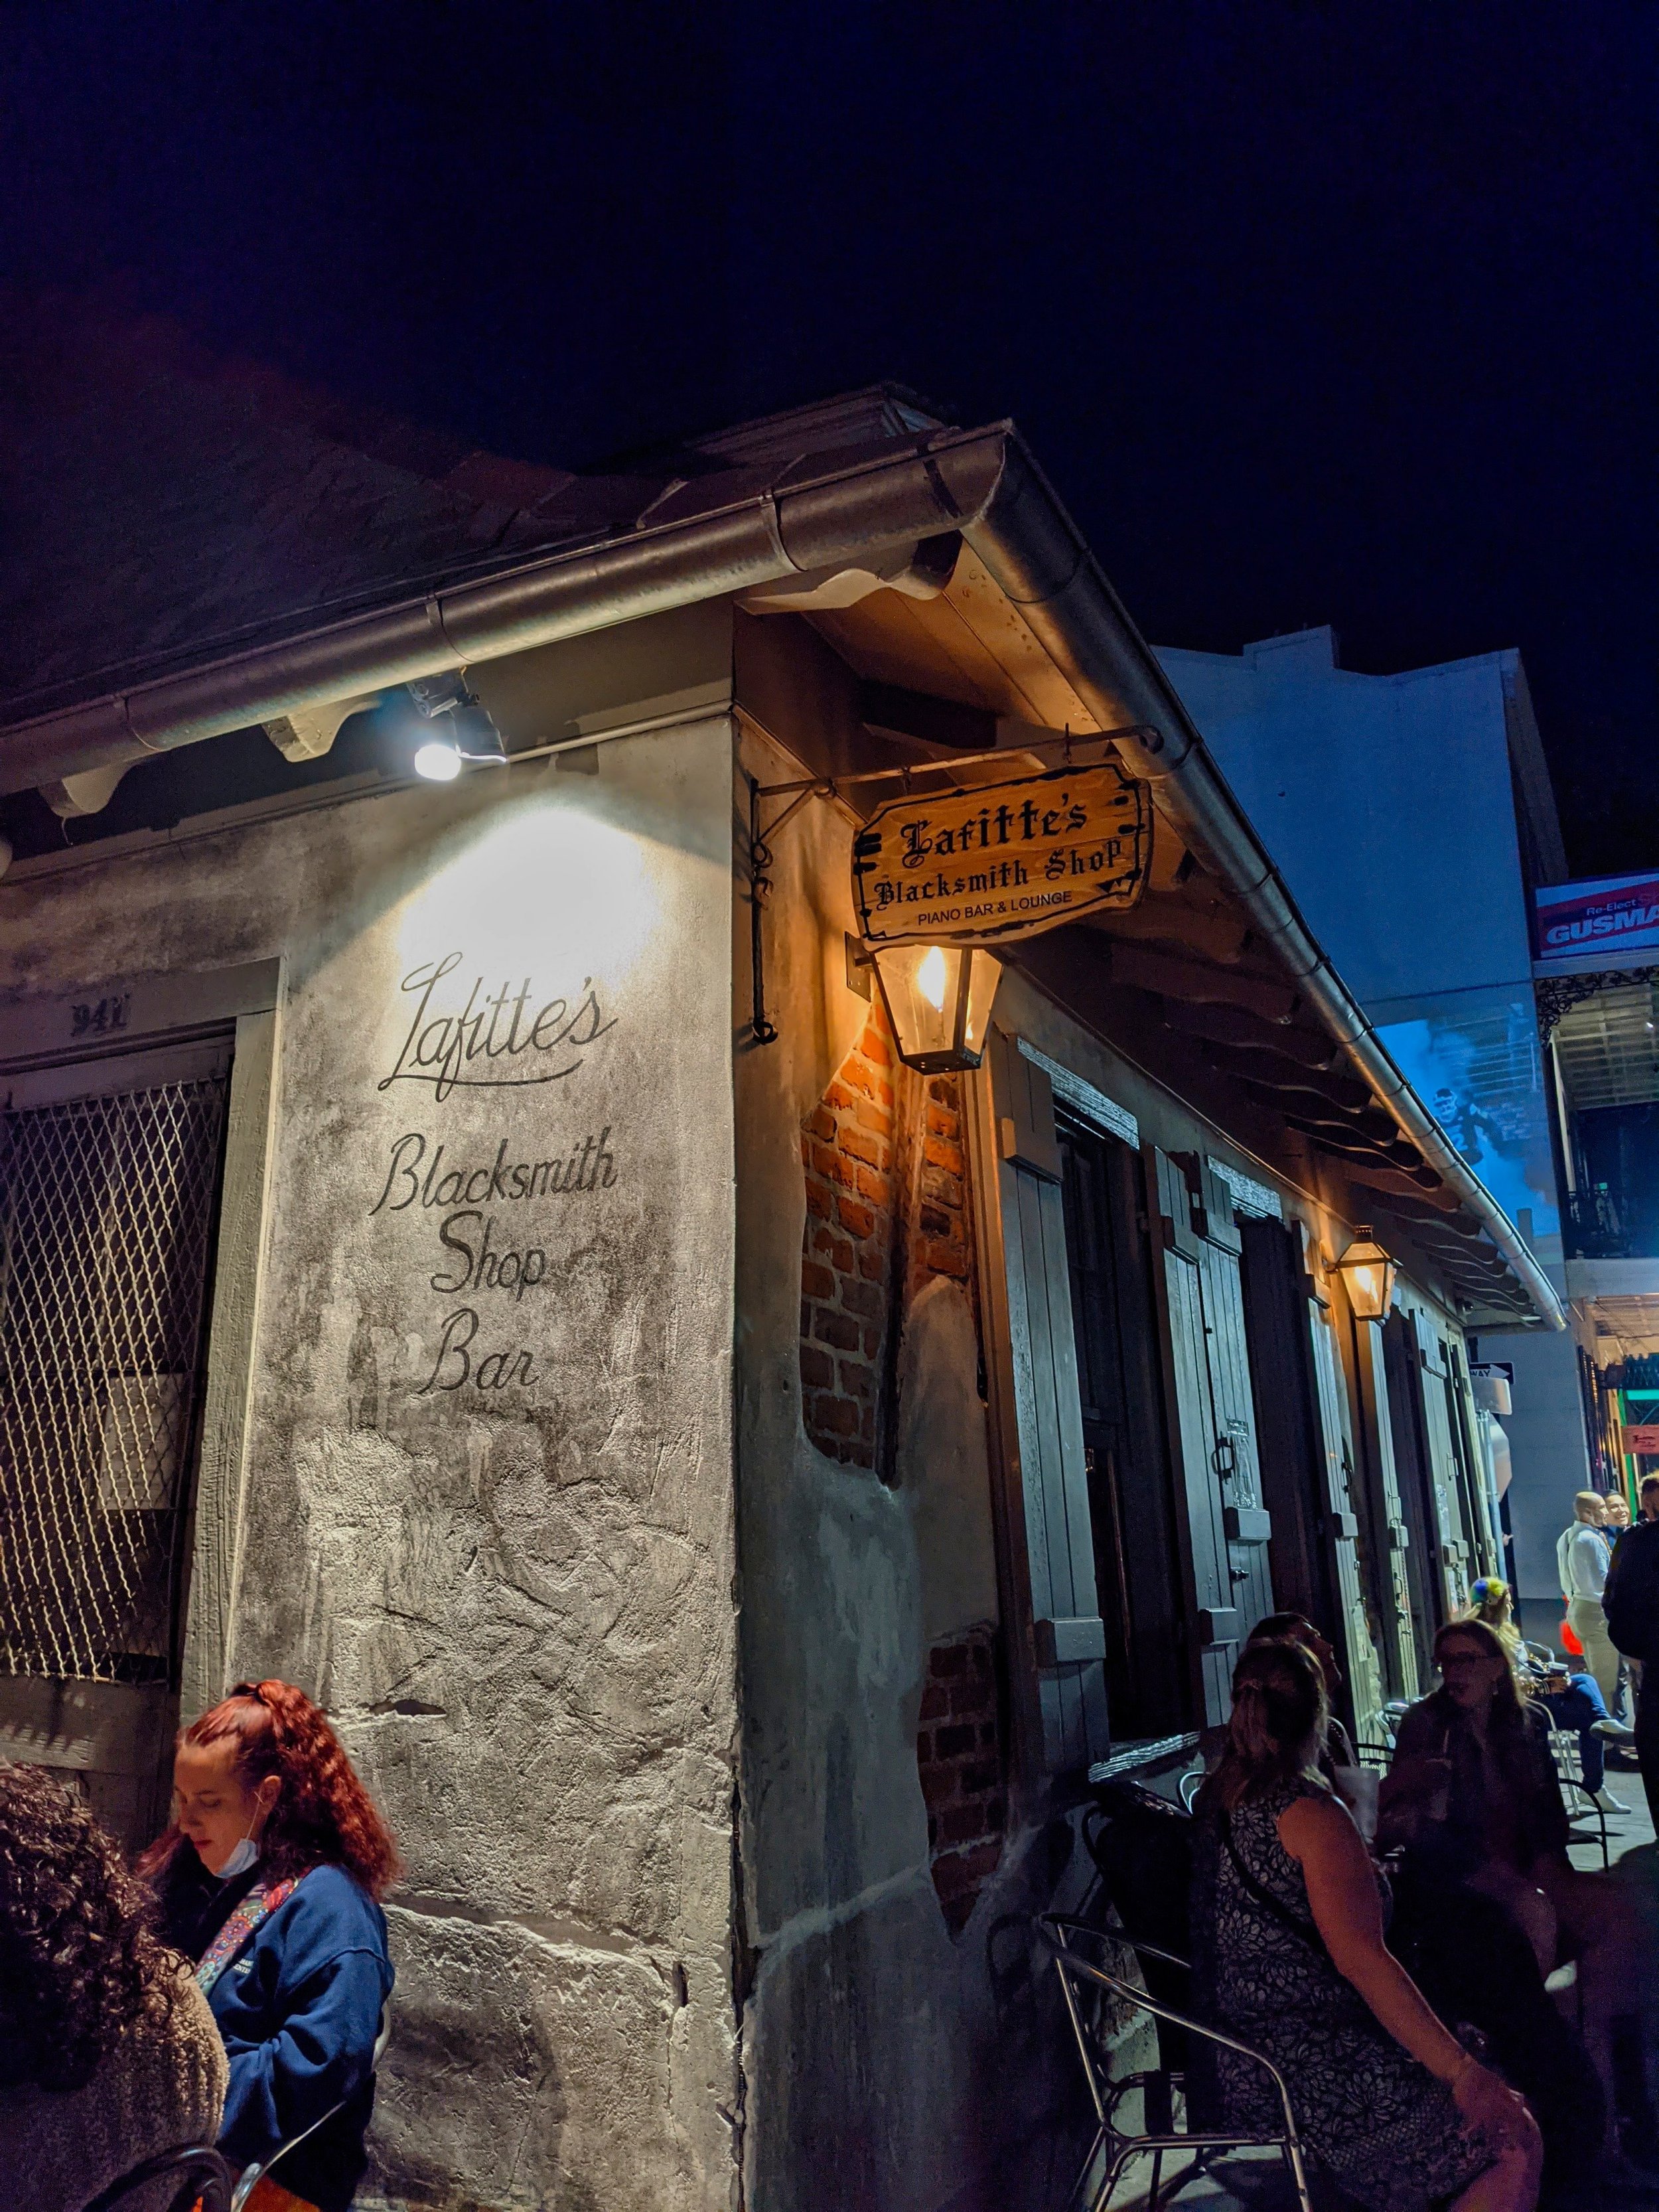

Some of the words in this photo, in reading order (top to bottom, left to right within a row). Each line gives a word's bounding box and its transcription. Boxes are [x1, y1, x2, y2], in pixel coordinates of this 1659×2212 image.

[901, 792, 1088, 868] Lafitte's
[874, 859, 1029, 911] Blacksmith
[1045, 837, 1121, 881] Shop
[918, 908, 961, 926] PIANO
[964, 903, 994, 918] BAR
[997, 901, 1007, 913] &
[1011, 890, 1072, 911] LOUNGE
[1587, 899, 1636, 916] Re-Elect
[378, 952, 619, 1103] Lafitte's
[368, 1126, 618, 1216] Blacksmith
[431, 1210, 548, 1301] Shop
[417, 1307, 540, 1394] Bar
